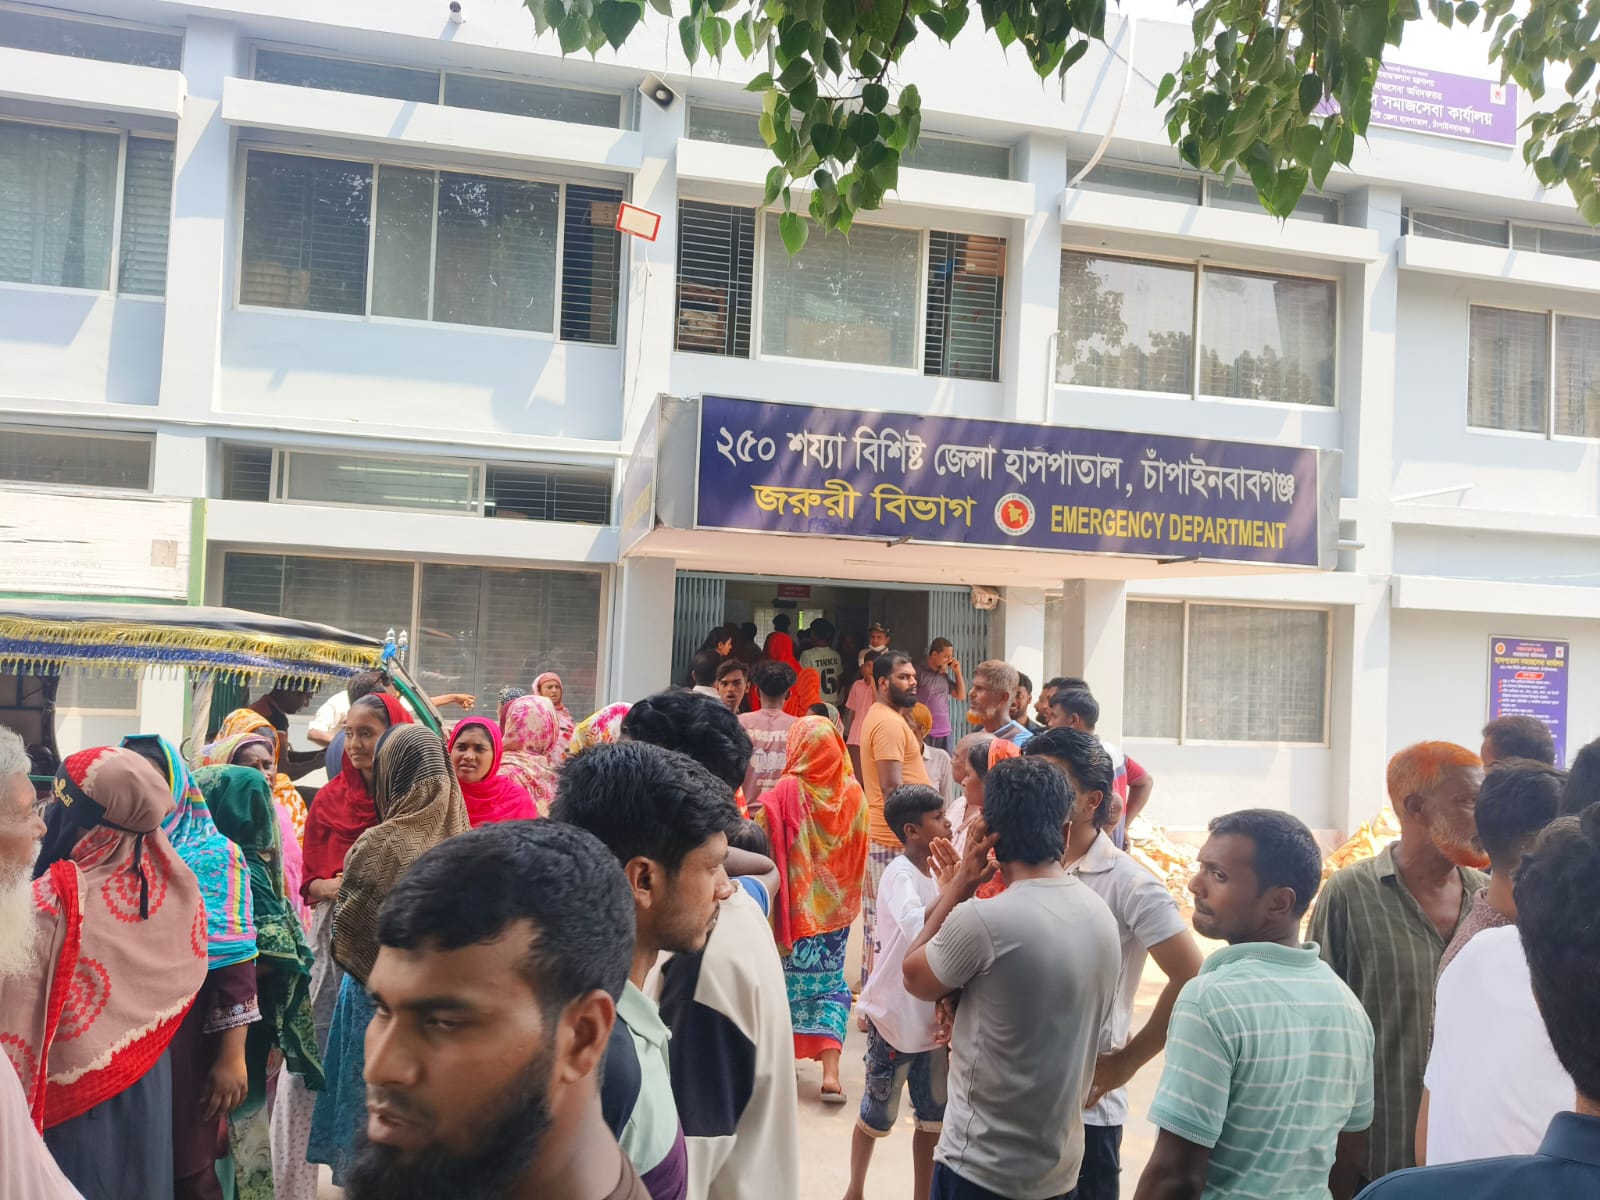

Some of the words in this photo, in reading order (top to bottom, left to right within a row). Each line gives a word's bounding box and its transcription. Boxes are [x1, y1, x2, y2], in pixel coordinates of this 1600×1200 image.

[1382, 95, 1445, 119] সমাজসেবা
[1447, 105, 1494, 127] কার্যালয়
[716, 426, 776, 467] ২৫০
[786, 429, 847, 470] শয্যা
[852, 426, 927, 474] বিশিষ্ট
[934, 439, 998, 481] জেলা
[1140, 448, 1295, 504] চাঁপাইনবাবগঞ্জ
[751, 478, 863, 521] জরুরী
[870, 483, 977, 528] বিভাগ
[1051, 504, 1165, 540] EMERGENCY
[1169, 513, 1287, 549] DEPARTMENT
